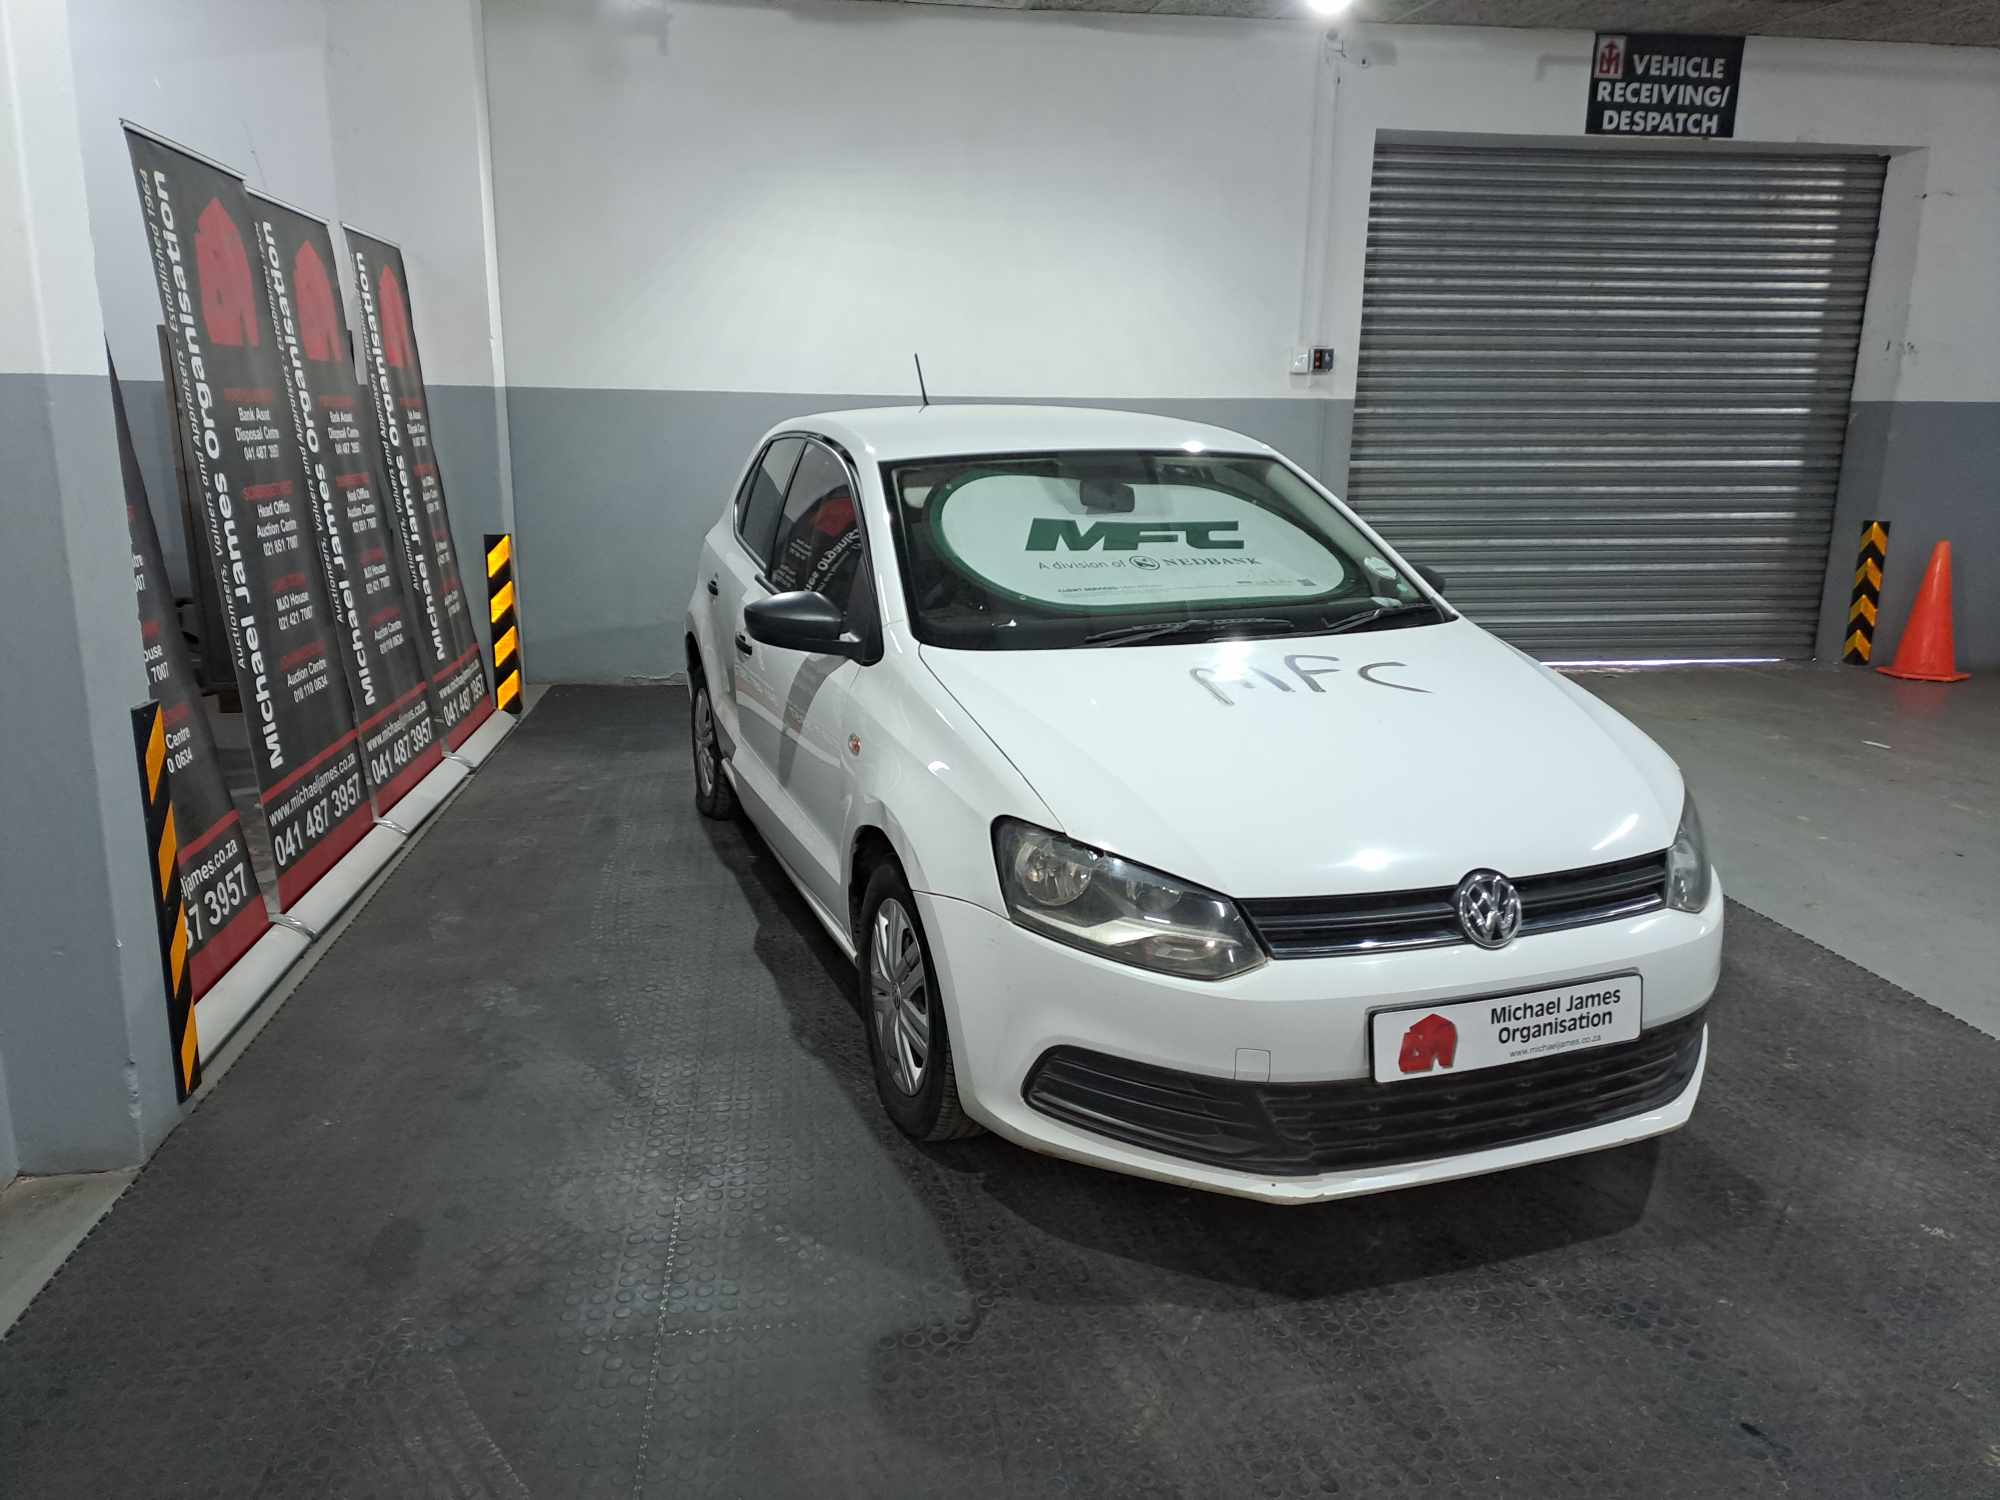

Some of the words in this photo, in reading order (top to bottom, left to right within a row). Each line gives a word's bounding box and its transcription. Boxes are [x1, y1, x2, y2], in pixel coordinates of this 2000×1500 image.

[1596, 81, 1731, 108] RECEIVING/
[1633, 54, 1726, 79] VEHICLE
[1602, 110, 1718, 135] DESPATCH
[139, 168, 156, 217] 1964
[149, 222, 179, 333] Established
[153, 170, 220, 460] Organisation
[262, 221, 319, 453] Organisation
[356, 252, 399, 447] Organisation
[177, 349, 202, 448] Appraisers
[194, 451, 209, 487] and
[298, 445, 311, 475] and
[205, 492, 224, 557] Valuers
[306, 479, 323, 531] Valuers
[314, 463, 347, 571] James
[395, 455, 422, 547] James
[214, 472, 251, 605] James
[1026, 517, 1244, 551] MFC
[1038, 561, 1050, 570] A
[1052, 560, 1109, 570] division
[1111, 559, 1126, 569] of
[1163, 557, 1263, 566] NEDBANK
[415, 554, 446, 661] Michael
[144, 644, 163, 662] ouse
[338, 580, 376, 706] Michael
[240, 615, 284, 770] Michael
[1189, 654, 1435, 706] MFC
[443, 698, 460, 727] 041
[371, 749, 393, 784] 041
[393, 734, 412, 766] 487
[410, 717, 433, 752] 3957
[268, 752, 357, 827] www.michaeljames.co.za
[274, 820, 304, 866] 041
[306, 798, 329, 839] 487
[331, 772, 361, 818] 3957
[204, 862, 247, 925] 3957
[1491, 997, 1561, 1025] Michael
[1566, 989, 1621, 1012] James
[1498, 1011, 1613, 1044] Organisation
